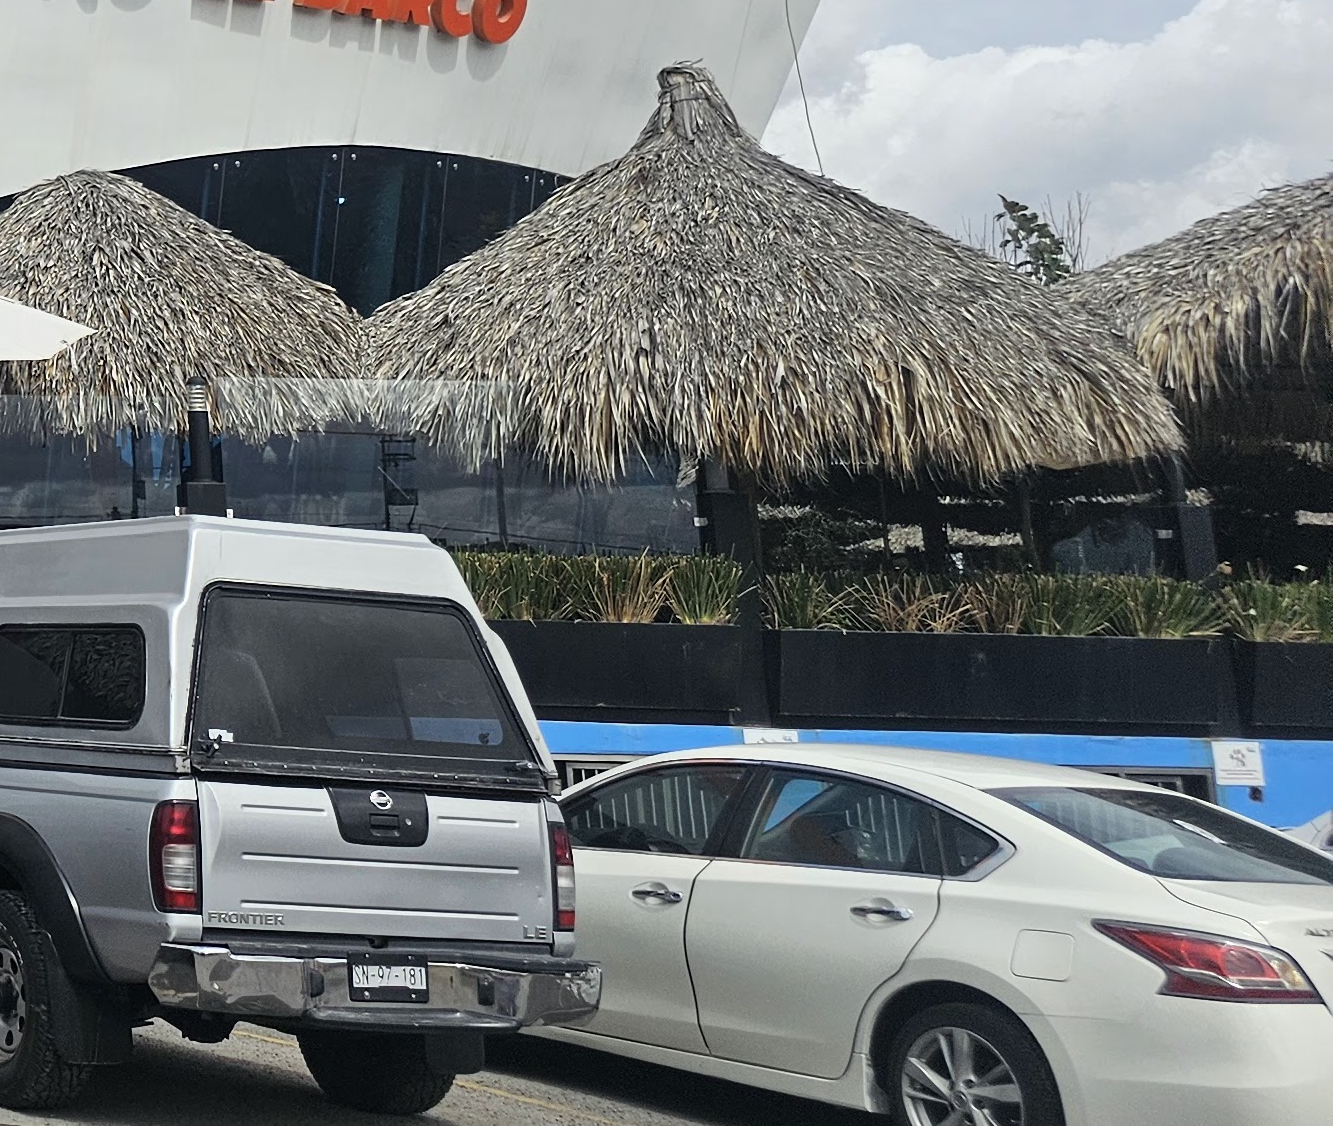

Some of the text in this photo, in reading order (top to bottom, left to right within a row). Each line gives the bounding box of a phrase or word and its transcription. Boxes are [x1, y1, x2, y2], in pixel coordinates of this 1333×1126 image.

[208, 910, 285, 925] FRONTIER
[523, 925, 547, 939] LE
[354, 965, 424, 987] SN-97-181
